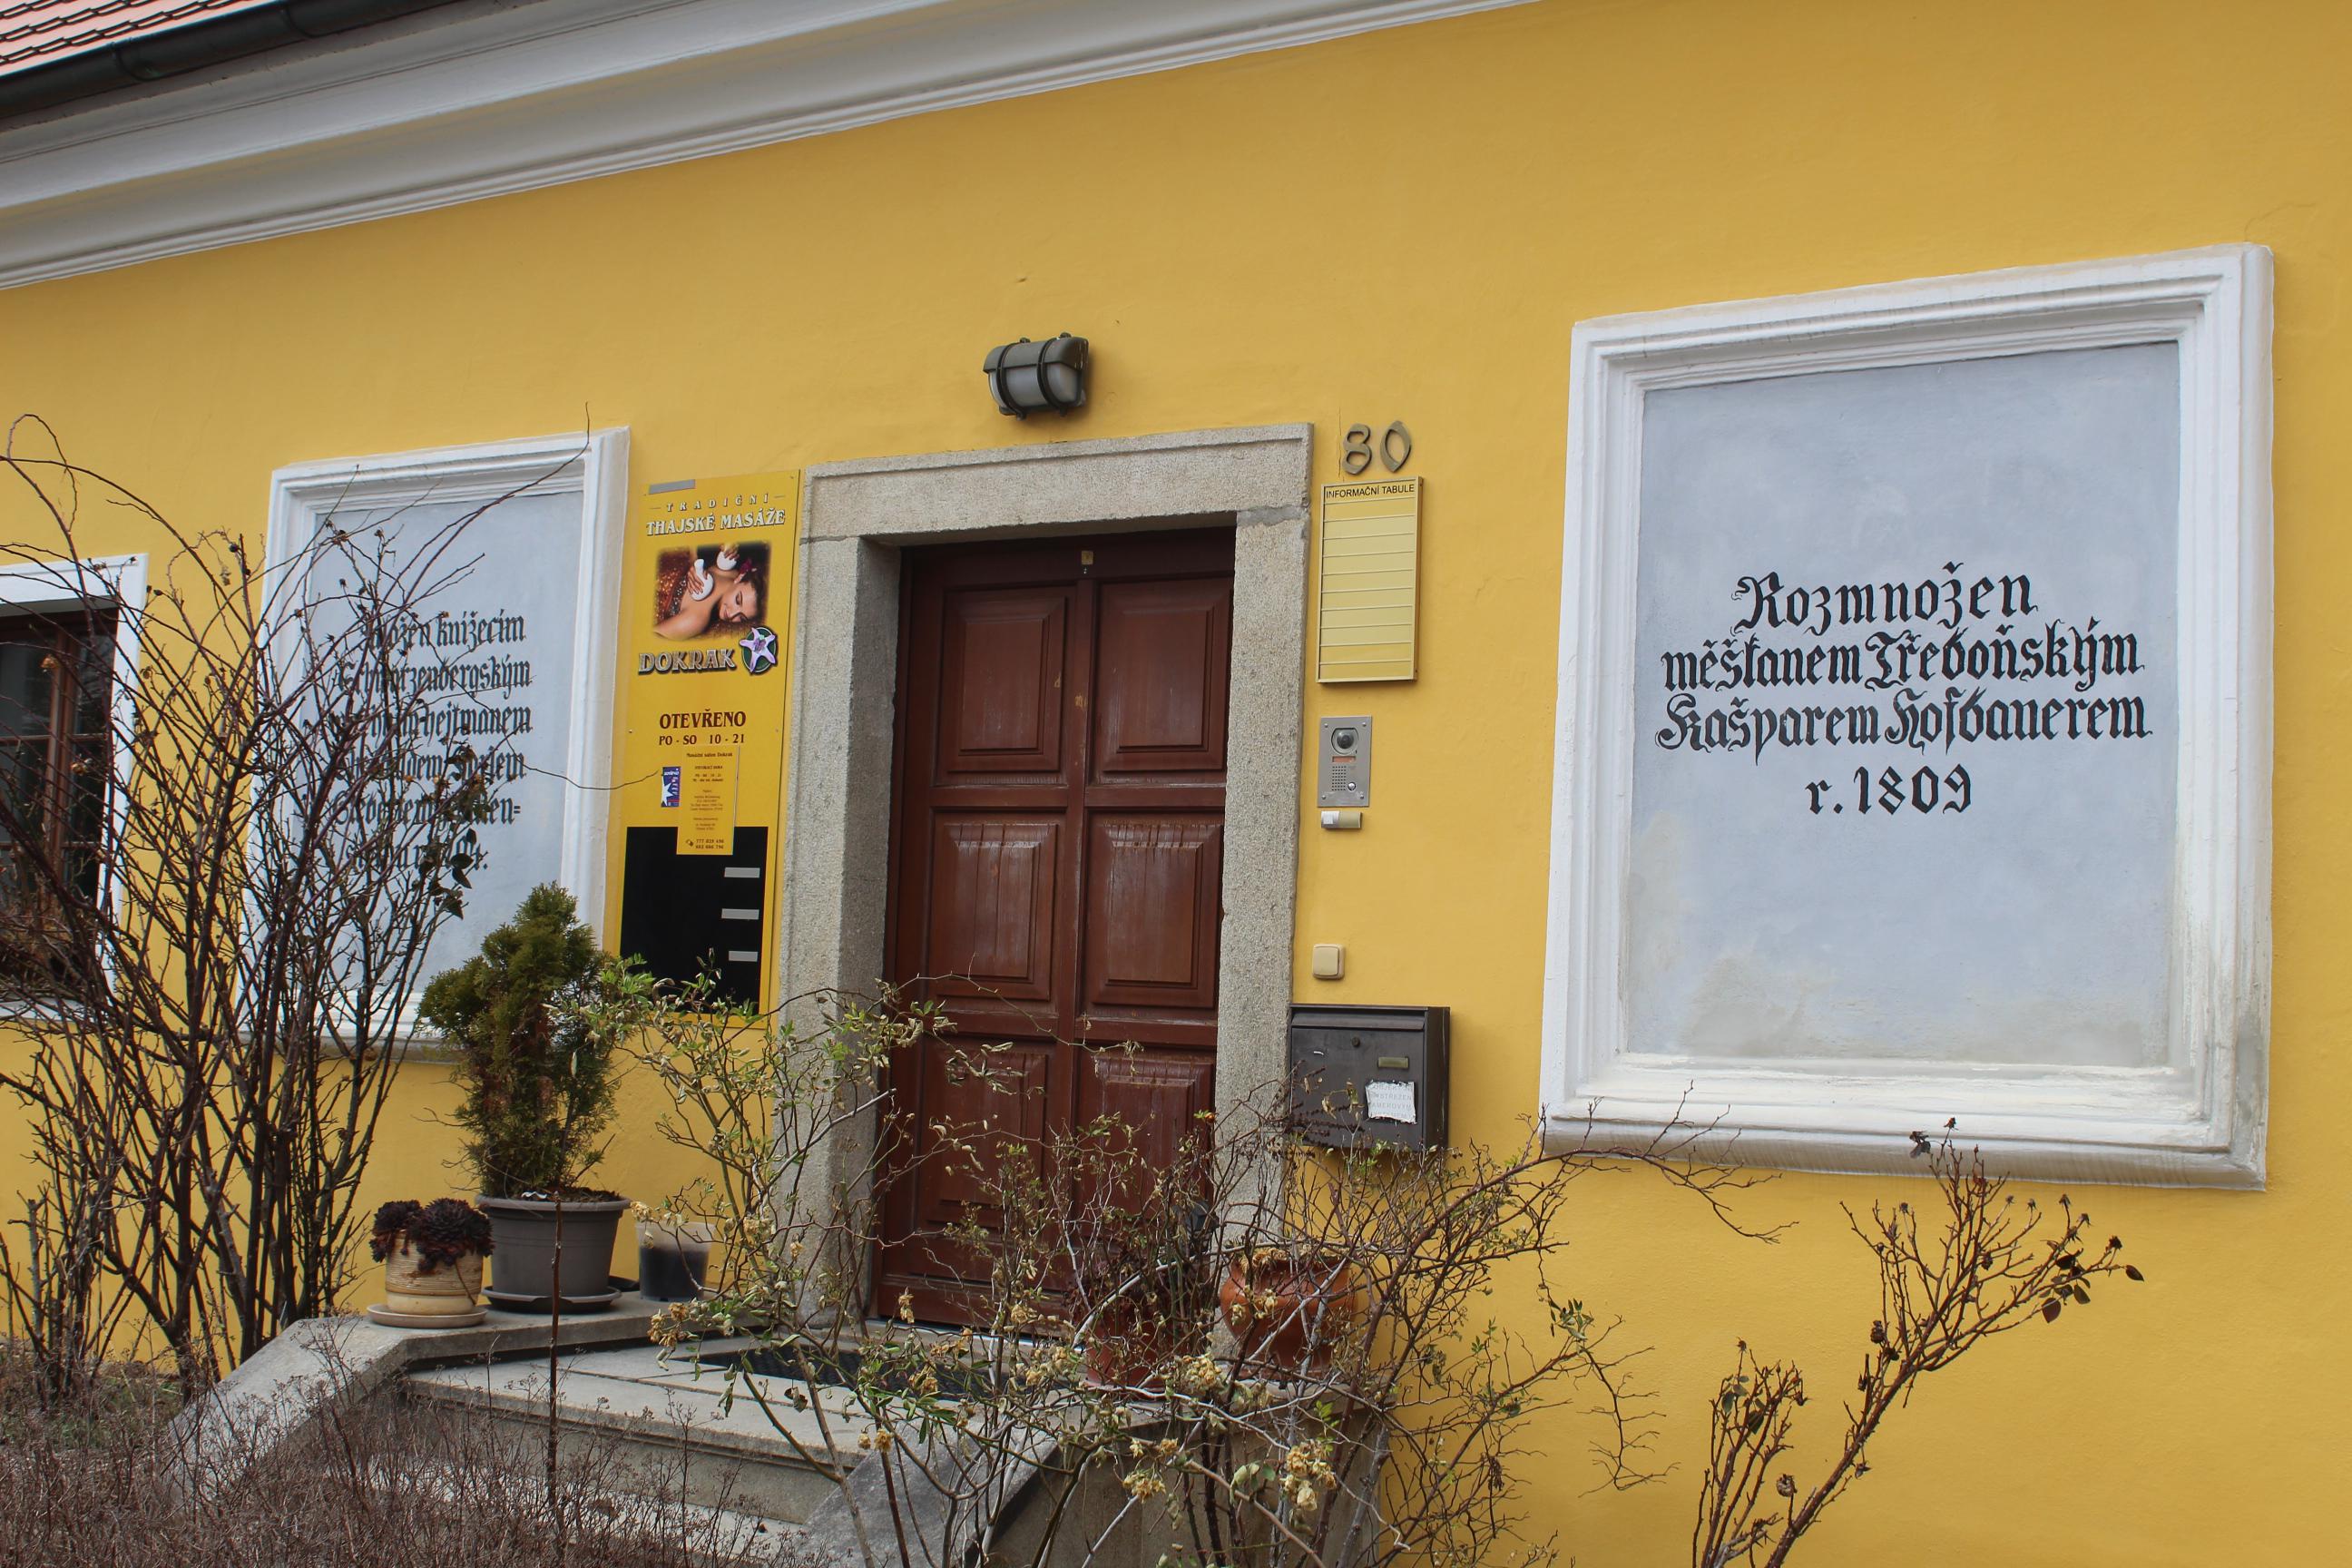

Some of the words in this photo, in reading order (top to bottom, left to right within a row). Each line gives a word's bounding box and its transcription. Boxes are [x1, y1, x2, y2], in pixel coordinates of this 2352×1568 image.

[1342, 420, 1412, 475] 80
[1326, 485, 1380, 499] INFORMAČNÍ
[1382, 484, 1416, 495] TABULE
[646, 513, 716, 536] THAJSKÉ
[720, 506, 786, 530] MASÁŽE
[1730, 561, 2038, 636] Rozmnožen
[638, 648, 737, 675] DOKRAK
[1865, 616, 2145, 692] Třeboňským
[659, 708, 747, 729] OTEVŘENO
[1655, 692, 1882, 766] Kašparem
[659, 736, 673, 746] PO
[682, 735, 698, 745] SO
[709, 734, 721, 744] 10
[732, 733, 745, 744] 21
[1804, 779, 1844, 815] r.
[1854, 763, 1972, 815] 1809
